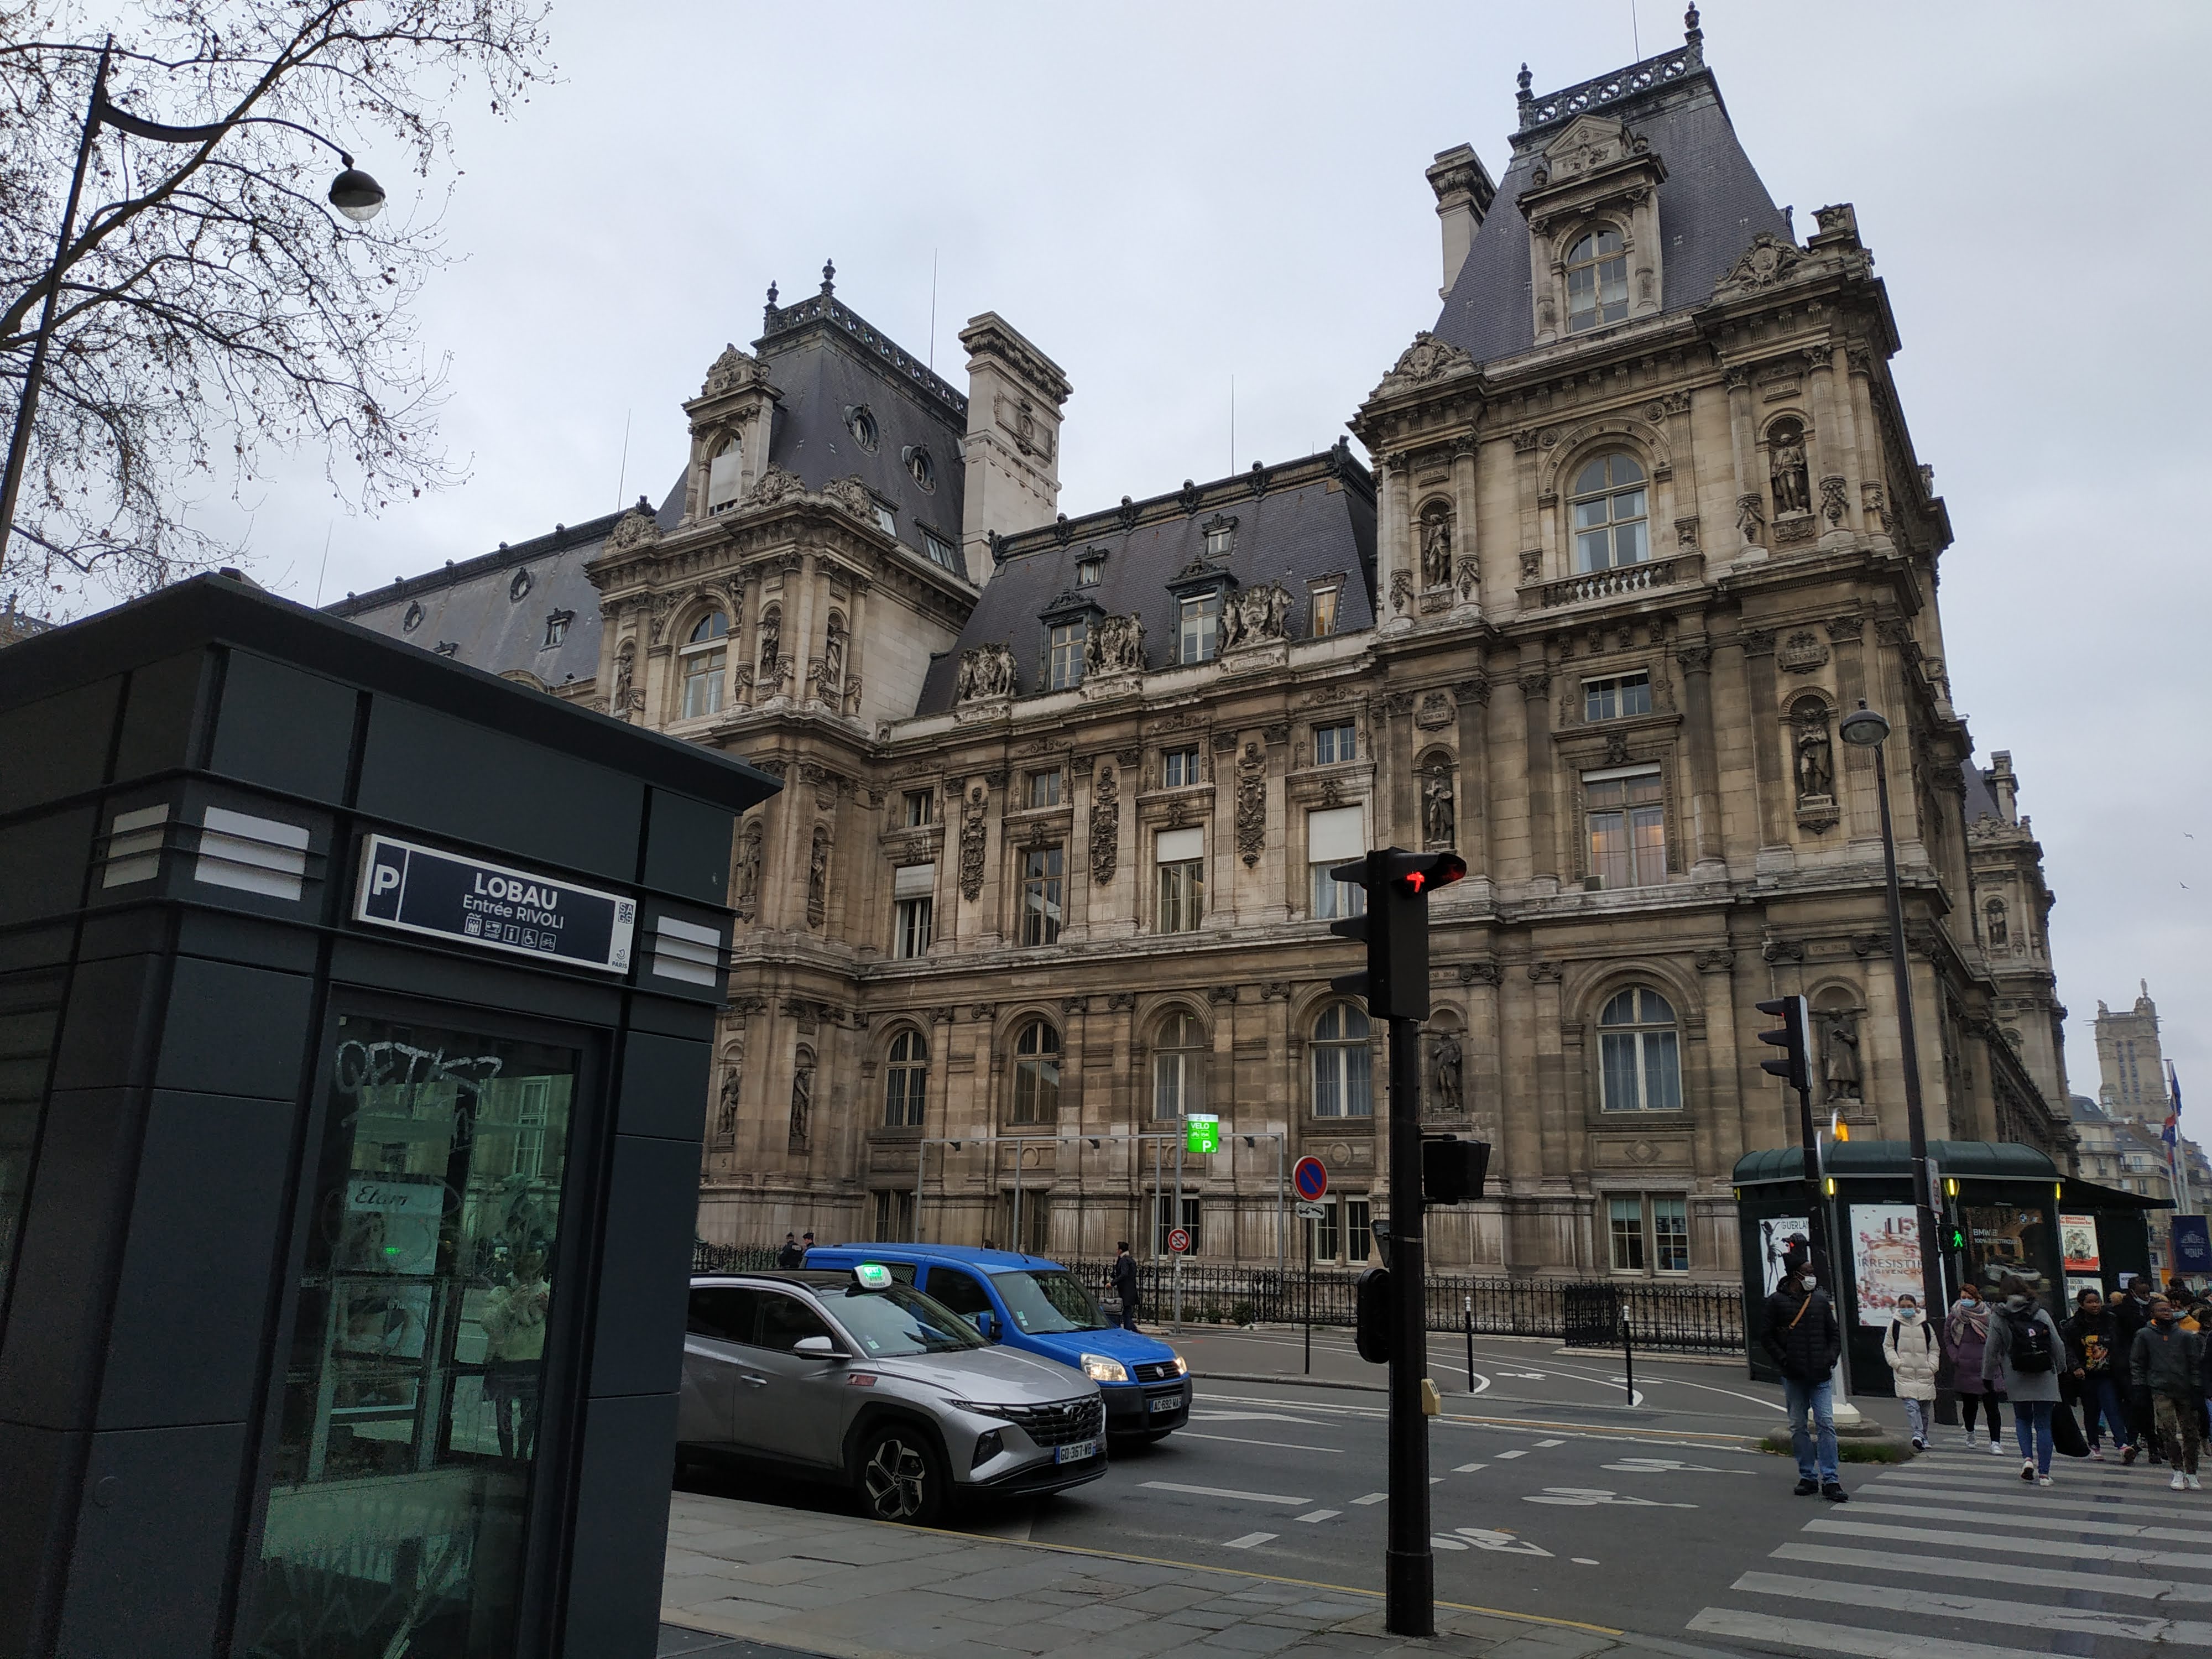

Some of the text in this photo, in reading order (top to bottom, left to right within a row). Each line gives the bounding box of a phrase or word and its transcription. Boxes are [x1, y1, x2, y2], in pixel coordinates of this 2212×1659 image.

[373, 864, 399, 895] P
[474, 872, 557, 910] LOBAU
[463, 894, 564, 929] Entrée RIVOLI
[1202, 1140, 1212, 1153] P
[722, 1158, 726, 1168] 5
[1973, 1228, 1991, 1237] BMW
